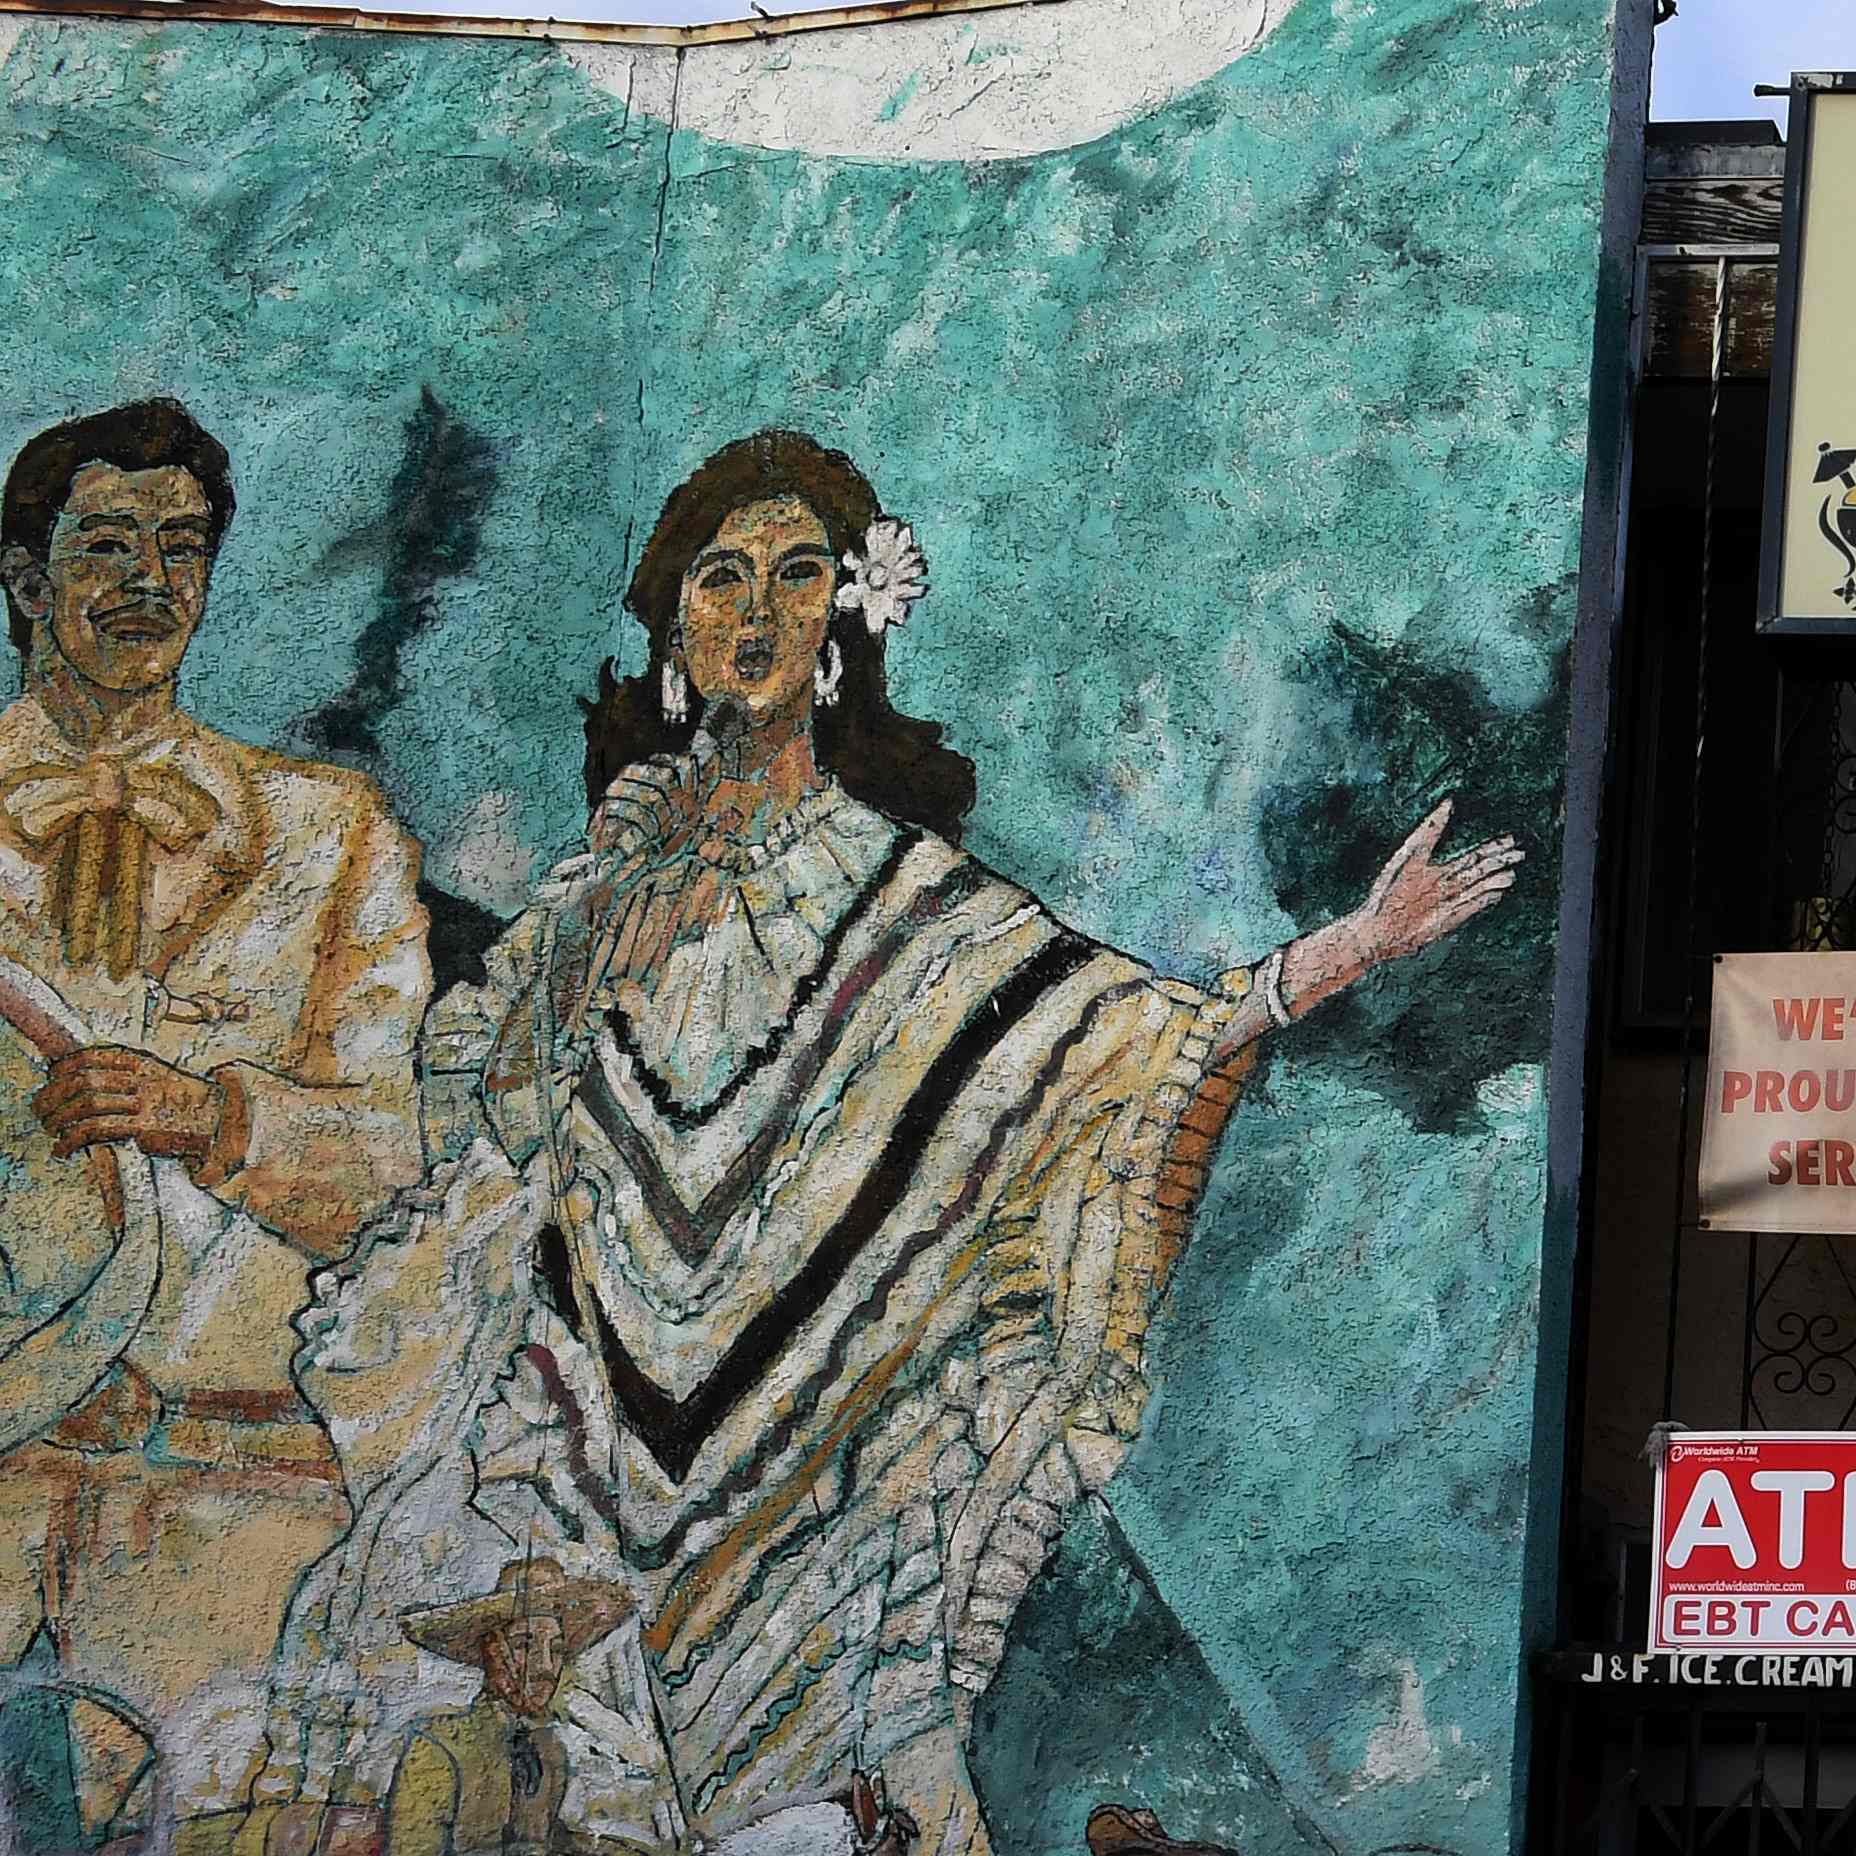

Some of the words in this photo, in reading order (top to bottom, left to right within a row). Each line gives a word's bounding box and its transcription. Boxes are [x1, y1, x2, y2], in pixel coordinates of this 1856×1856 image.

[1682, 1445, 1734, 1456] Worldwide
[1736, 1446, 1759, 1455] ATM
[1672, 1599, 1771, 1638] EBT
